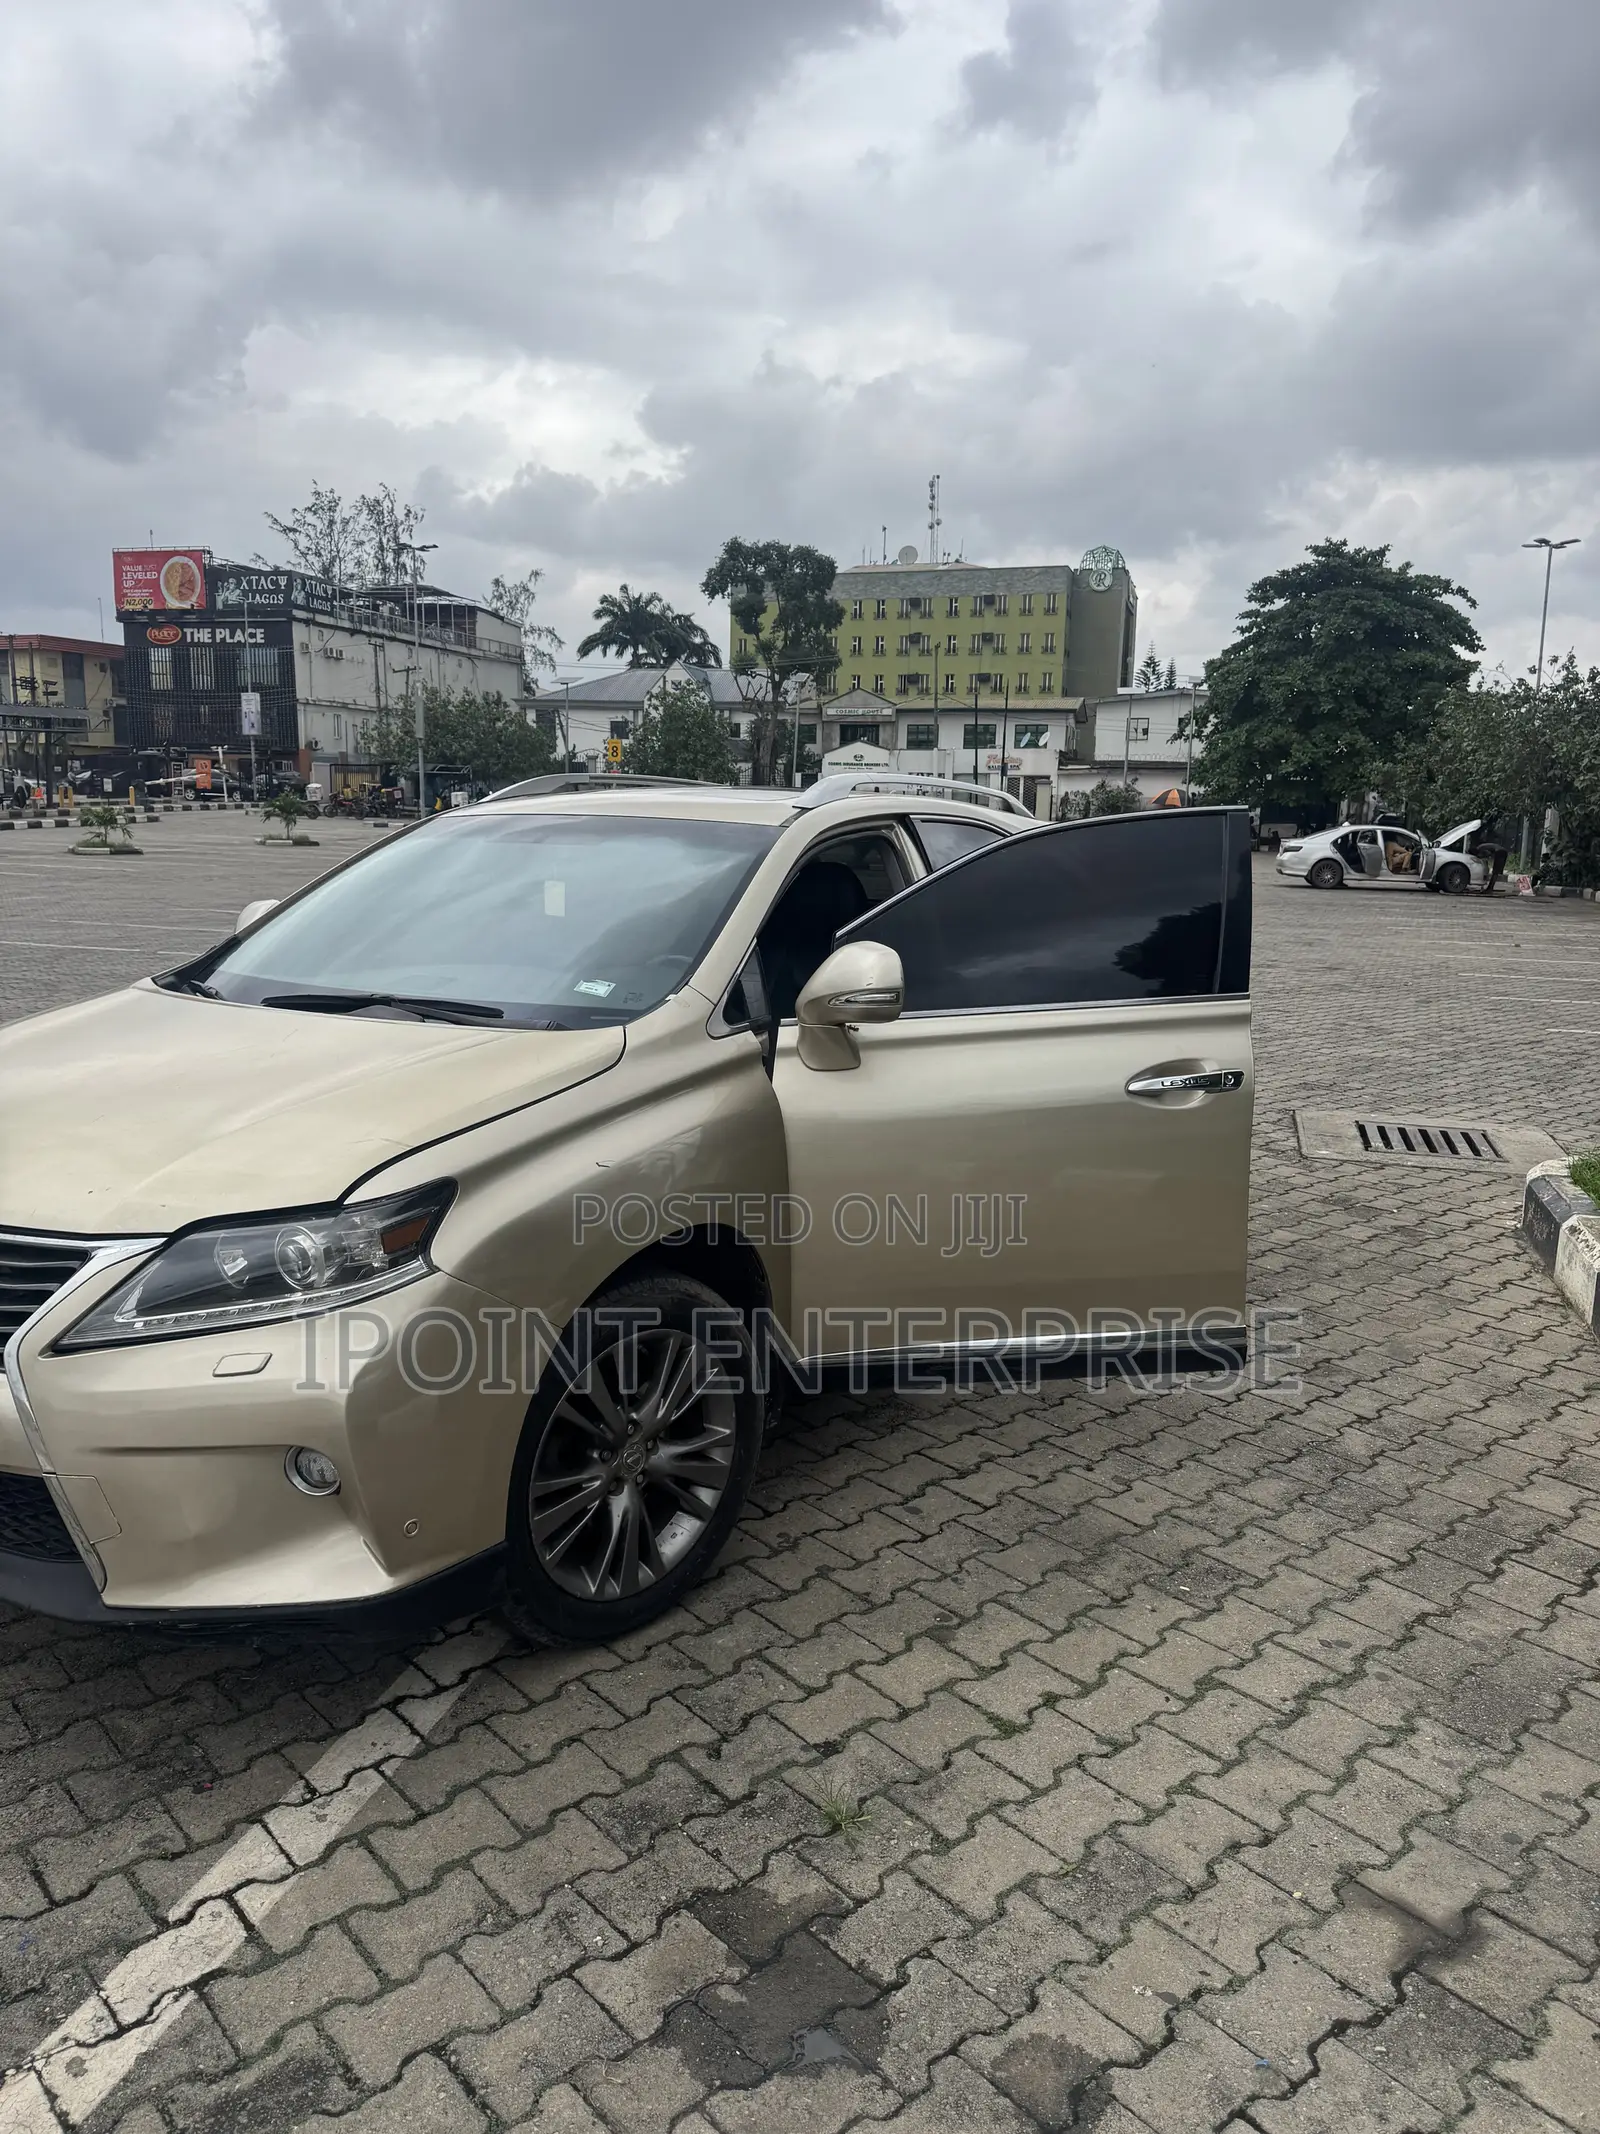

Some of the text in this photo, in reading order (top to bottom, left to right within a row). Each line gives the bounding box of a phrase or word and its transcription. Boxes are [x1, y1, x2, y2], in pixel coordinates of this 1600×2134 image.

[122, 571, 158, 580] LEVELED
[123, 580, 135, 588] UP
[183, 628, 212, 643] THE
[215, 628, 265, 643] PLACE
[611, 745, 619, 757] 8
